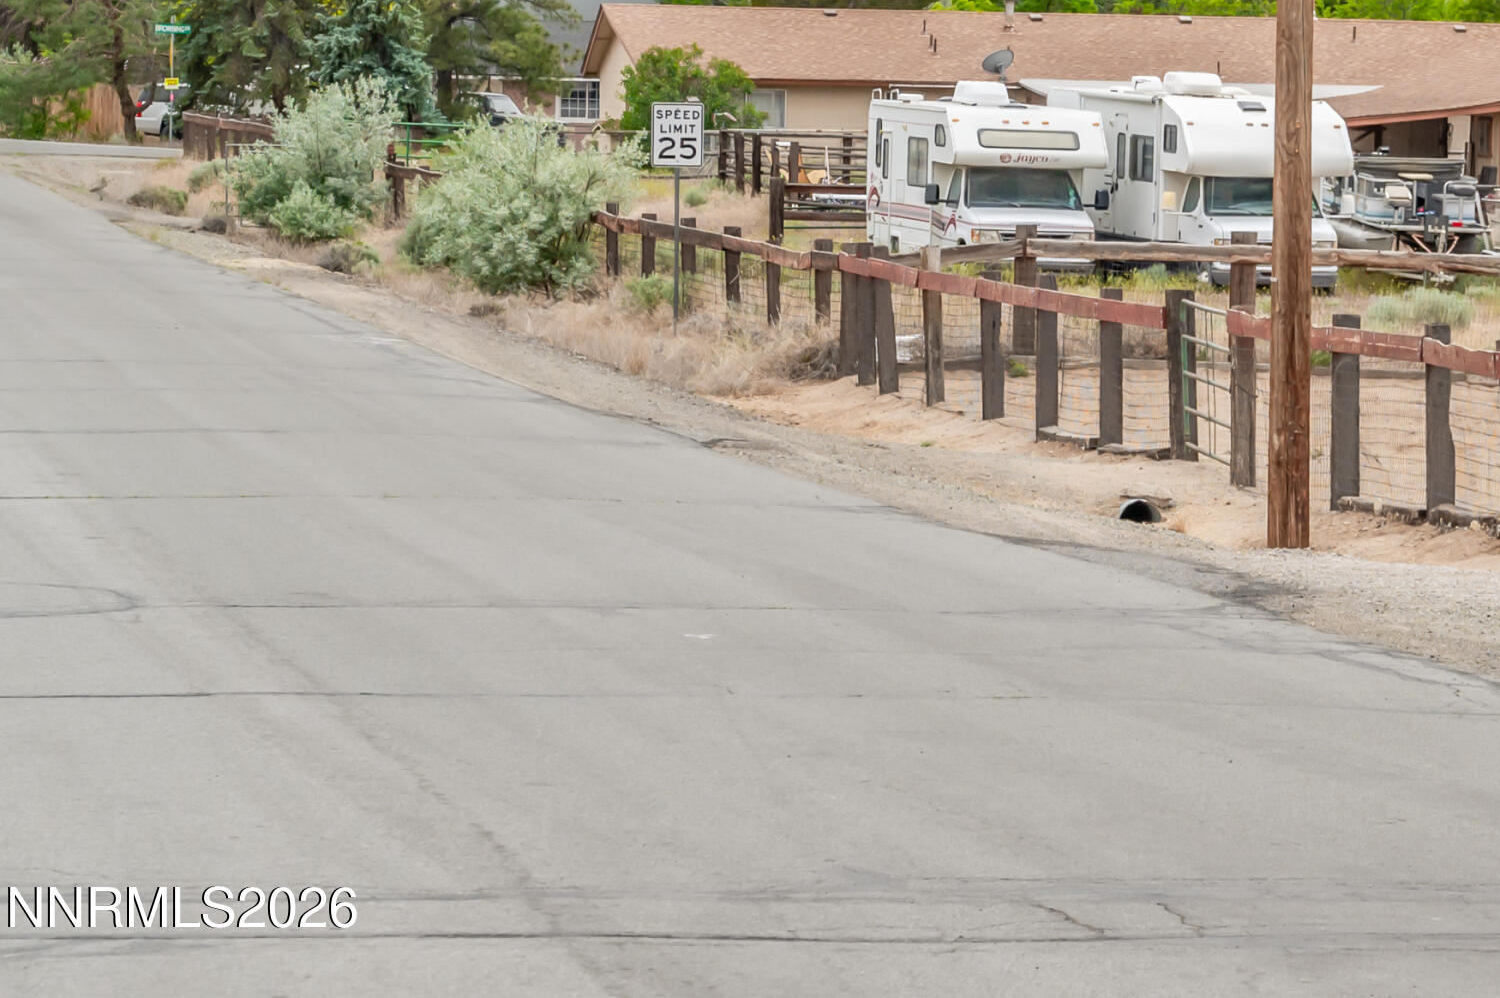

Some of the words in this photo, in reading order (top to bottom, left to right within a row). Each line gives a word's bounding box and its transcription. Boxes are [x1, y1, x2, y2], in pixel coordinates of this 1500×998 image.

[656, 110, 700, 120] SPEED
[660, 125, 696, 134] LIMIT
[658, 137, 697, 159] 25
